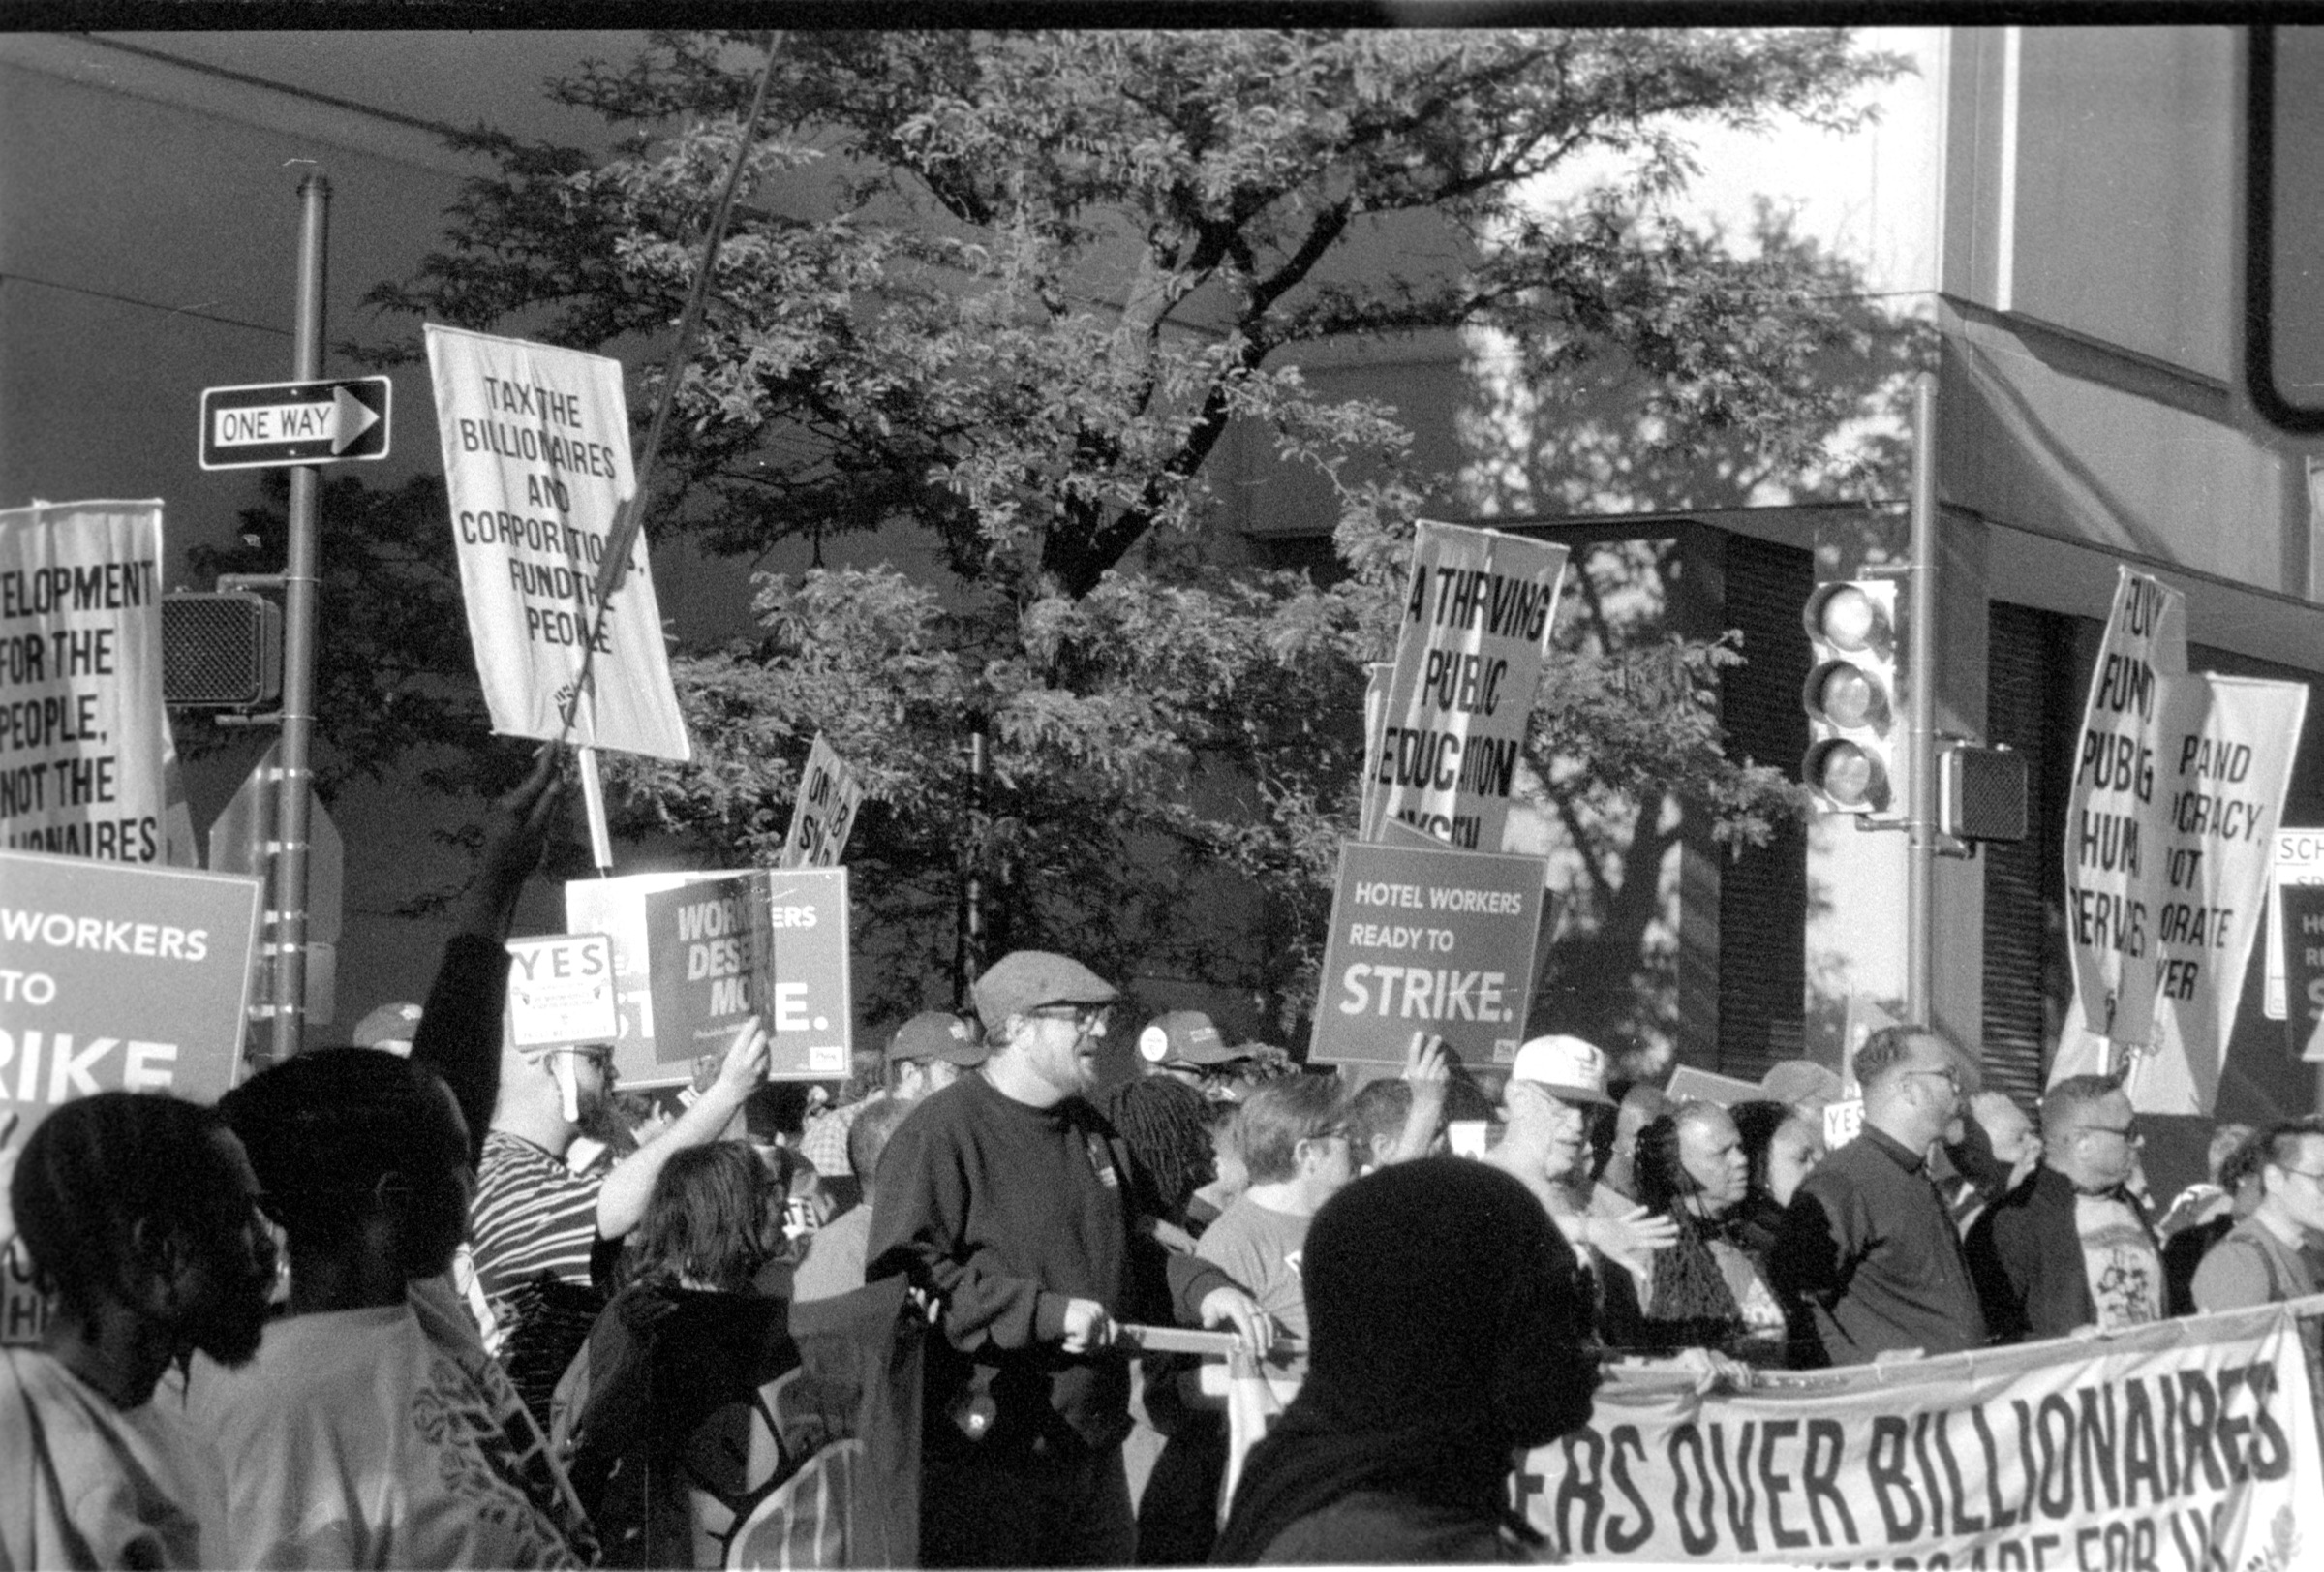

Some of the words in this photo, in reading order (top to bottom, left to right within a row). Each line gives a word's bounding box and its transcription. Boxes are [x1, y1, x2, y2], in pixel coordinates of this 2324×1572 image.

[223, 411, 269, 442] ONE
[281, 407, 330, 438] WAY
[485, 376, 535, 416] TAX
[535, 387, 581, 428] THE
[460, 418, 616, 479] BILLIONAIRES
[528, 474, 571, 513] AND
[509, 557, 573, 599] FUND
[572, 571, 615, 611] TH
[1405, 565, 1426, 623] A
[52, 628, 113, 677] THE
[1, 763, 47, 819] NOT
[55, 756, 115, 807] THE
[1356, 882, 1423, 909] HOTEL
[1430, 887, 1523, 916] WORKERS
[1, 908, 209, 962] WORKERS
[1350, 923, 1423, 950] READY
[1428, 929, 1455, 952] TO
[0, 971, 56, 1005] TO
[510, 943, 604, 981] YES
[1339, 963, 1514, 1023] STRIKE.
[1667, 1418, 1860, 1557] OVER
[1868, 1361, 2291, 1544] BILLIONAIRES
